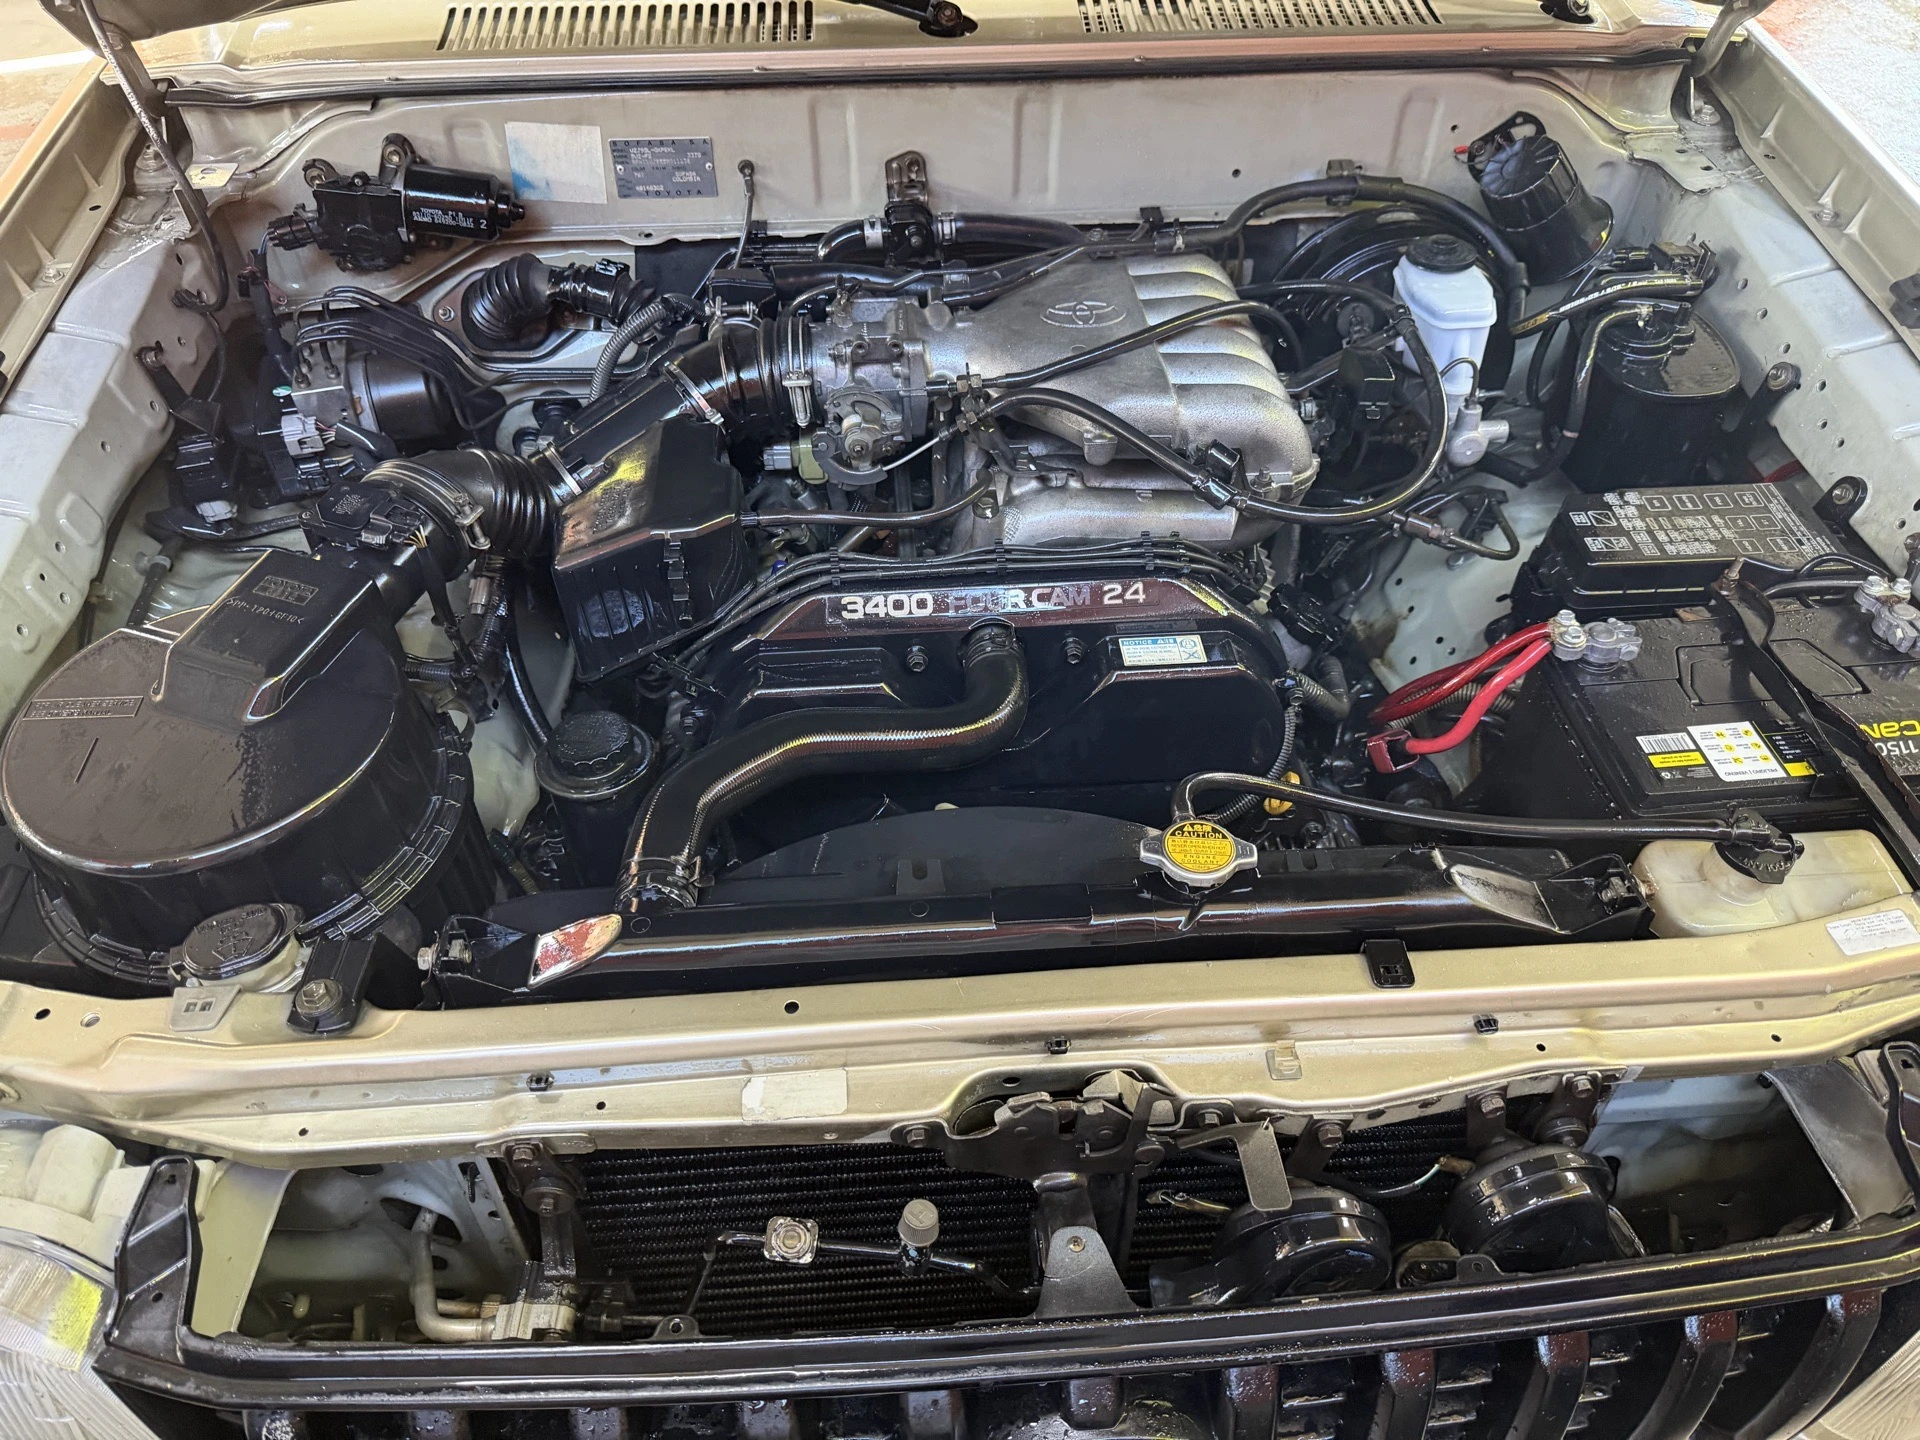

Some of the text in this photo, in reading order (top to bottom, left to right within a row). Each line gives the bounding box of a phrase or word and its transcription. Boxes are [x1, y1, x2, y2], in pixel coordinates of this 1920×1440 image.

[645, 189, 703, 197] TOYOTA
[479, 219, 488, 230] 2
[840, 592, 933, 620] 3400
[1031, 584, 1091, 611] CAM
[1103, 581, 1146, 605] 24
[1175, 830, 1223, 839] CAUTION
